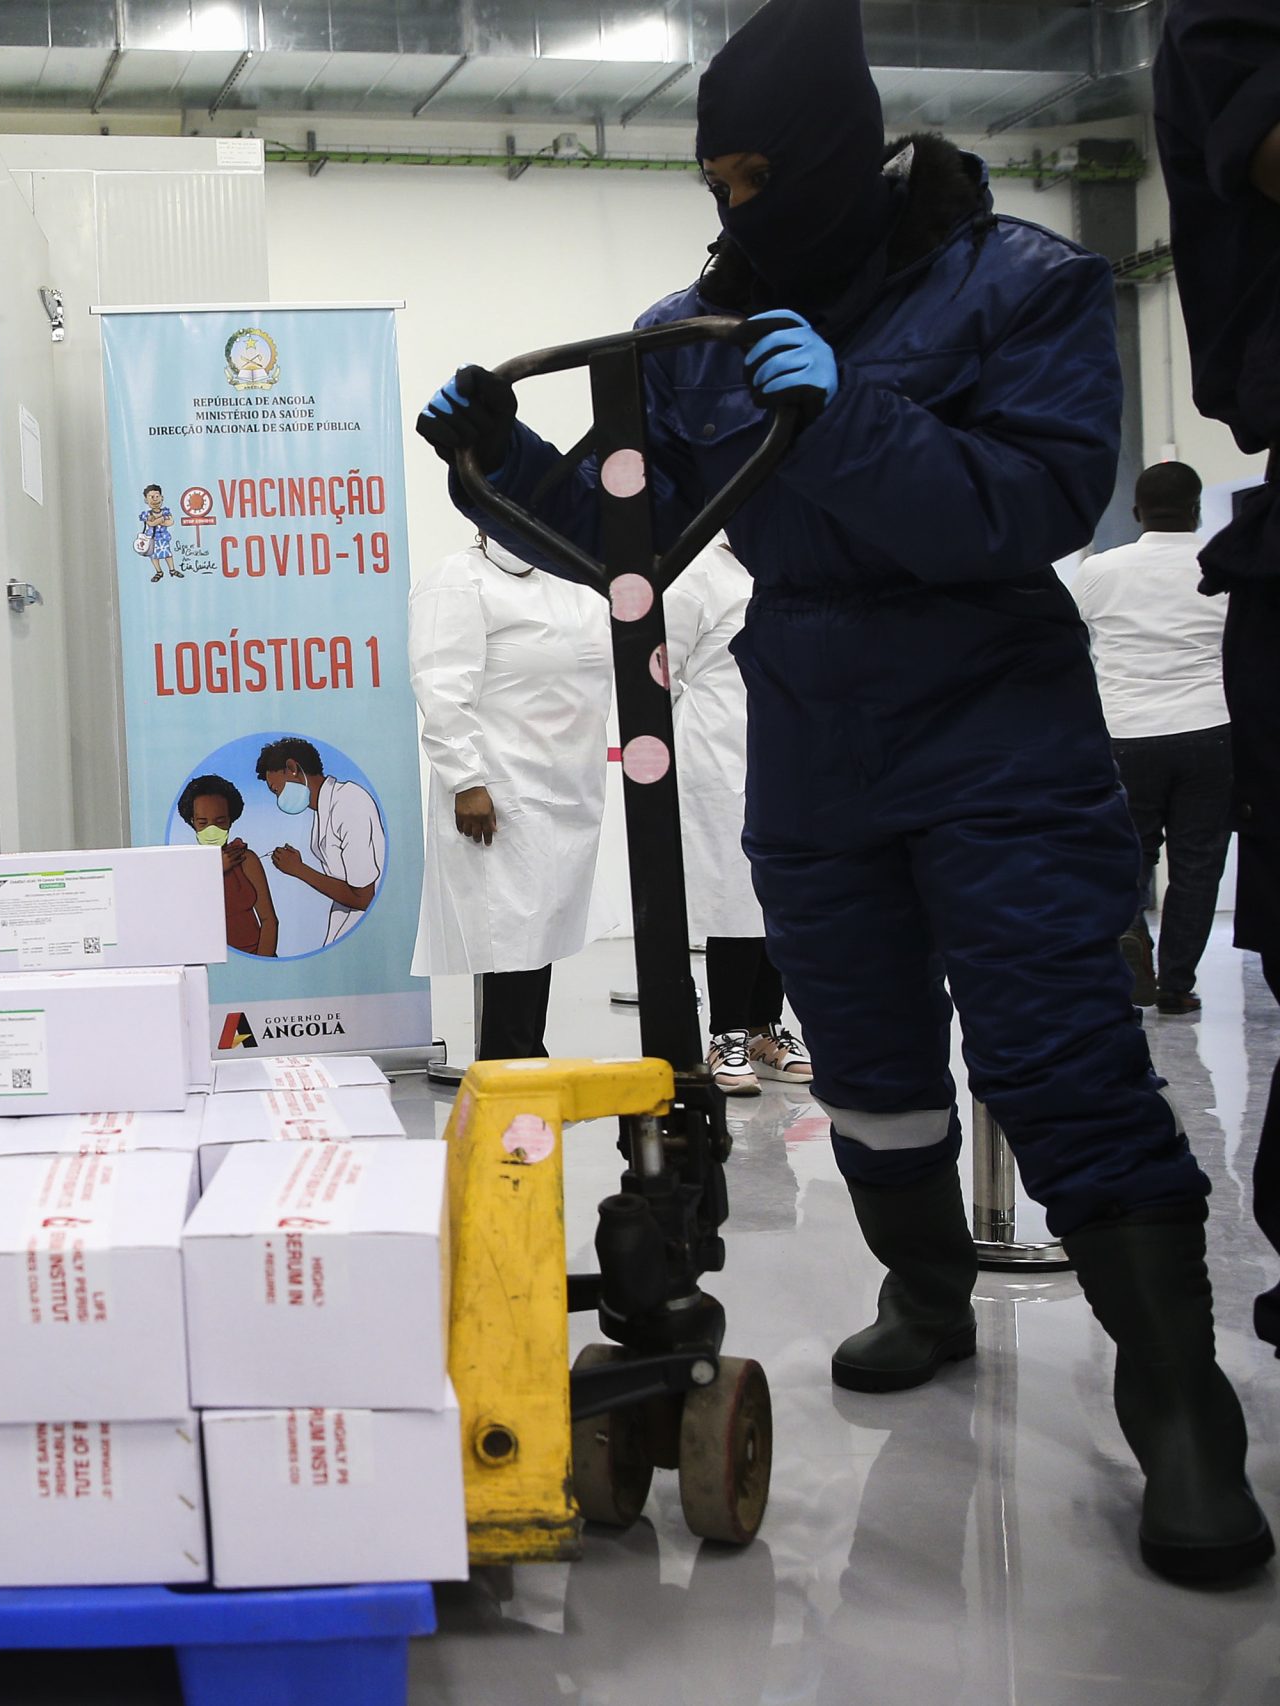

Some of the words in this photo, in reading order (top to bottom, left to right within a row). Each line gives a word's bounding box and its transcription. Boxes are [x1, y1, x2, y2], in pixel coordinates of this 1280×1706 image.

[193, 395, 253, 407] REPÚBLICA
[255, 397, 270, 406] DE
[272, 395, 315, 406] ANGOLA
[196, 408, 259, 421] MINISTÉRIO
[262, 410, 277, 419] DA
[279, 408, 315, 419] SAÚDE
[148, 424, 203, 437] DIRECÇÃO
[205, 424, 260, 434] NACIONAL
[262, 424, 277, 433] DE
[279, 422, 314, 432] SAÚDE
[317, 421, 361, 431] PÚBLICA
[218, 468, 386, 524] VACINAÇÃO
[220, 532, 390, 578] COVID-19
[154, 628, 353, 697] LOGÍSTICA
[365, 635, 381, 688] 1
[265, 1013, 321, 1024] GOVERNO
[262, 1021, 345, 1040] ANGOLA
[72, 1435, 89, 1455] OF
